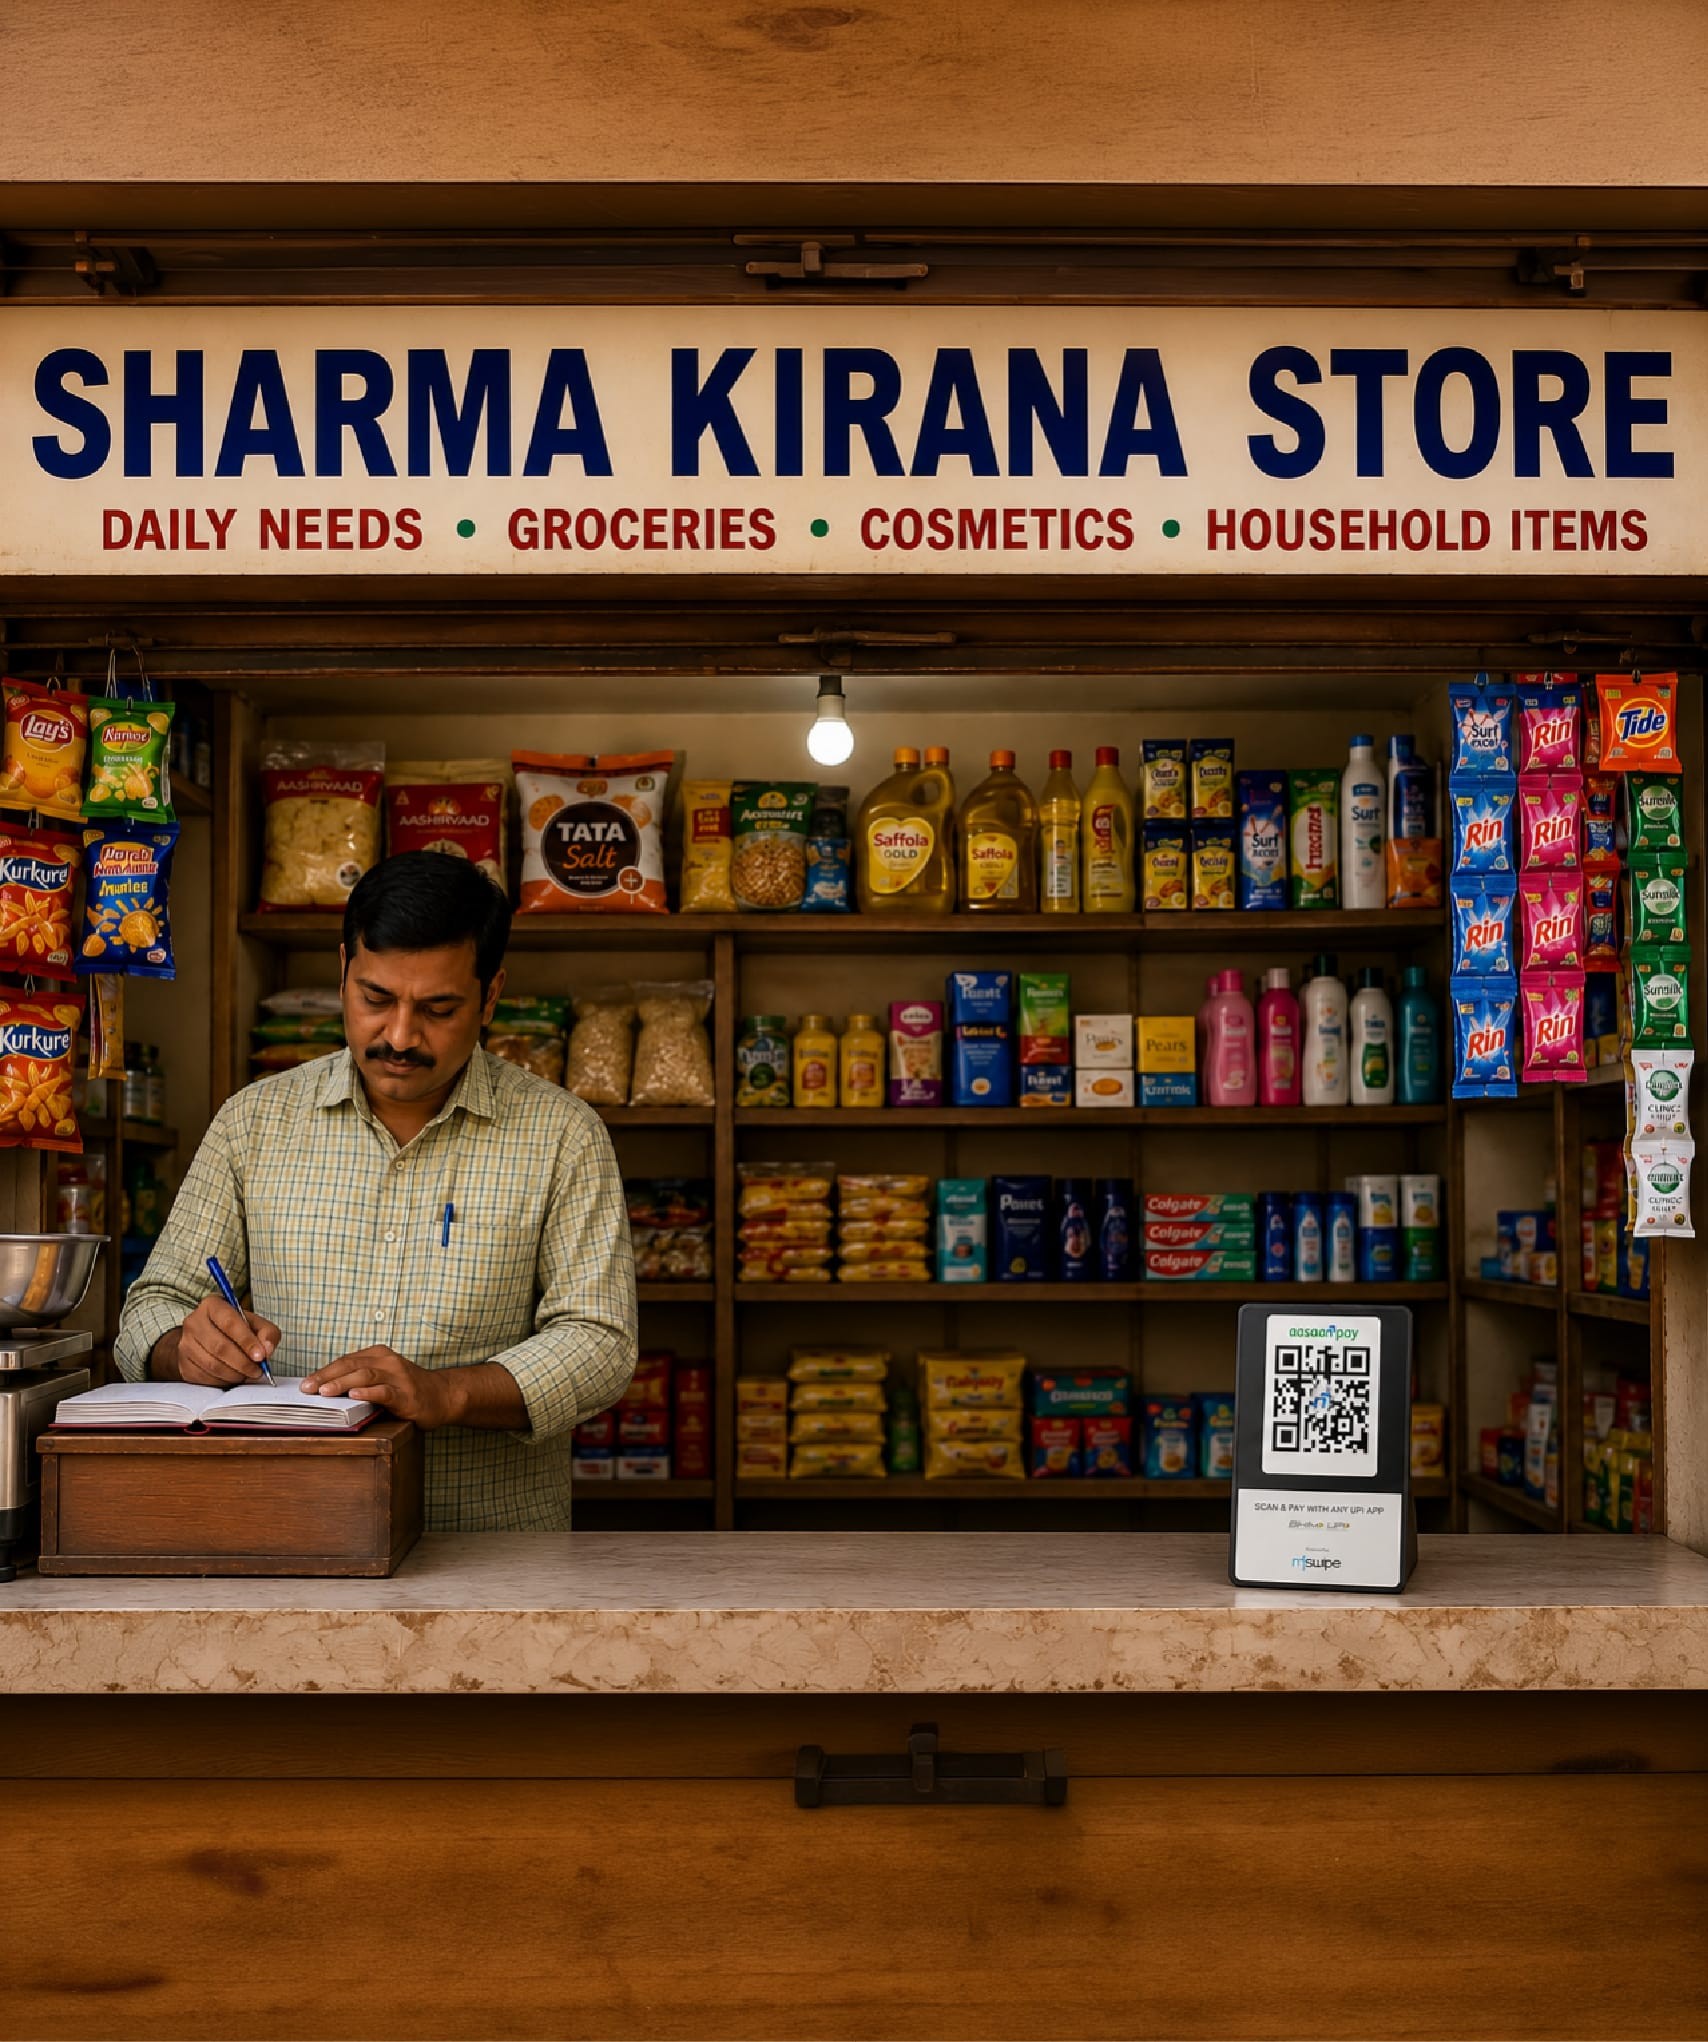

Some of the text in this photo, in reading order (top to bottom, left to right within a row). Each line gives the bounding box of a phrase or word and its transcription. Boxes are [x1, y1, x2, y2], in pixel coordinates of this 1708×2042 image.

[32, 345, 1675, 480] SHARMA KIRANA STORE
[102, 508, 1648, 551] DAILY NEEDS GROCERIES COSMETICS HOUSEHOLD ITEMS
[23, 714, 70, 743] Lay's
[1471, 724, 1498, 738] Surf
[1534, 718, 1573, 749] Rin
[1619, 708, 1667, 742] Tide
[1351, 805, 1381, 821] Surf
[556, 821, 627, 843] TATA
[873, 832, 929, 847] Saffola
[1252, 832, 1279, 848] Surf
[1465, 819, 1503, 850] Rin
[1534, 815, 1573, 849] Rin
[562, 844, 617, 870] Salt
[0, 858, 68, 889] Kurkure
[1465, 919, 1503, 952] Rin
[1534, 915, 1574, 946] Rin
[0, 1026, 70, 1058] Kurkure
[1146, 1038, 1187, 1053] Pears
[1467, 1024, 1505, 1059] Rin
[1536, 1014, 1574, 1047] Rin
[1148, 1197, 1202, 1213] Colgate
[1150, 1225, 1203, 1241] Colgate
[1150, 1254, 1203, 1270] Colgate
[1254, 1502, 1279, 1512] SCAN
[1288, 1503, 1305, 1513] PAY
[1306, 1505, 1330, 1513] WITH
[1330, 1506, 1349, 1514] ANY
